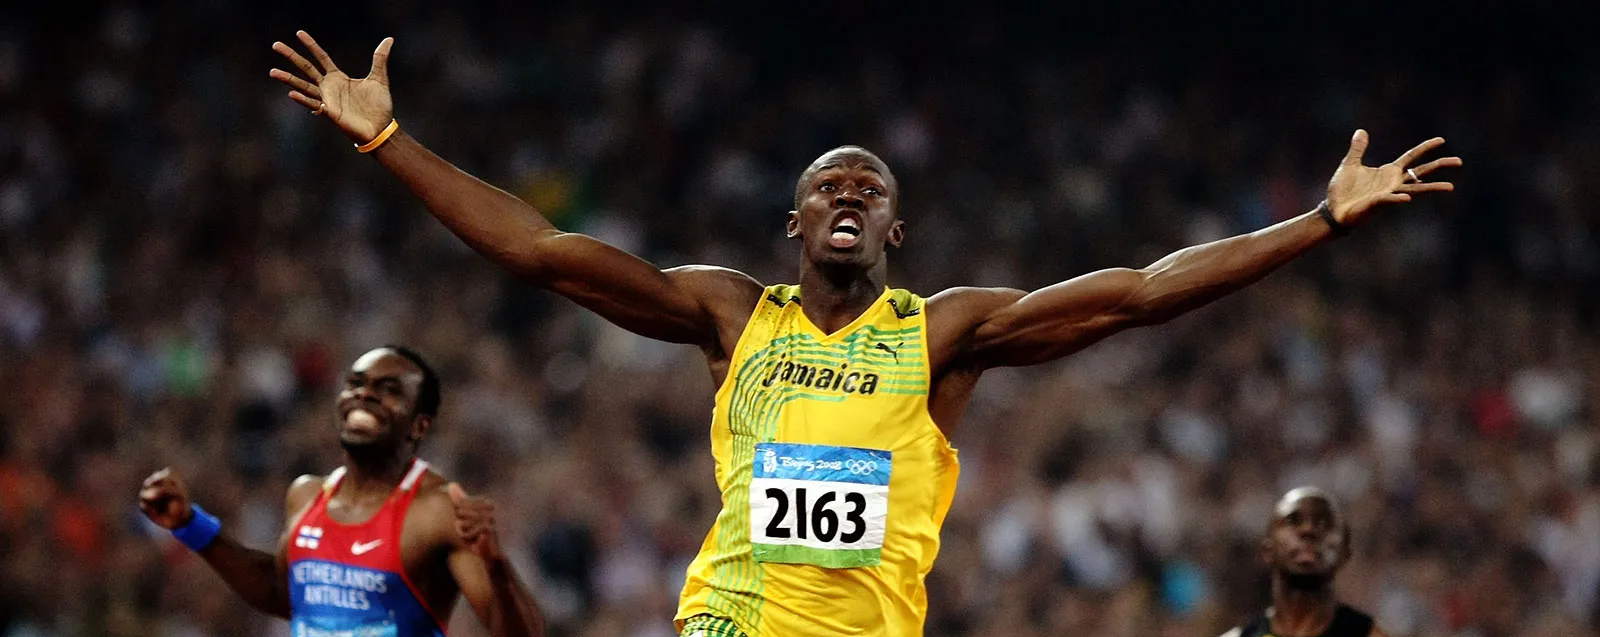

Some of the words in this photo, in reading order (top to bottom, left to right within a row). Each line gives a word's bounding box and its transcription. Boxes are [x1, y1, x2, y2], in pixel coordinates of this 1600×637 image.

[780, 456, 815, 472] Beijing
[815, 459, 842, 471] 2008
[765, 487, 867, 544] 2163
[304, 584, 370, 610] ANTILLES
